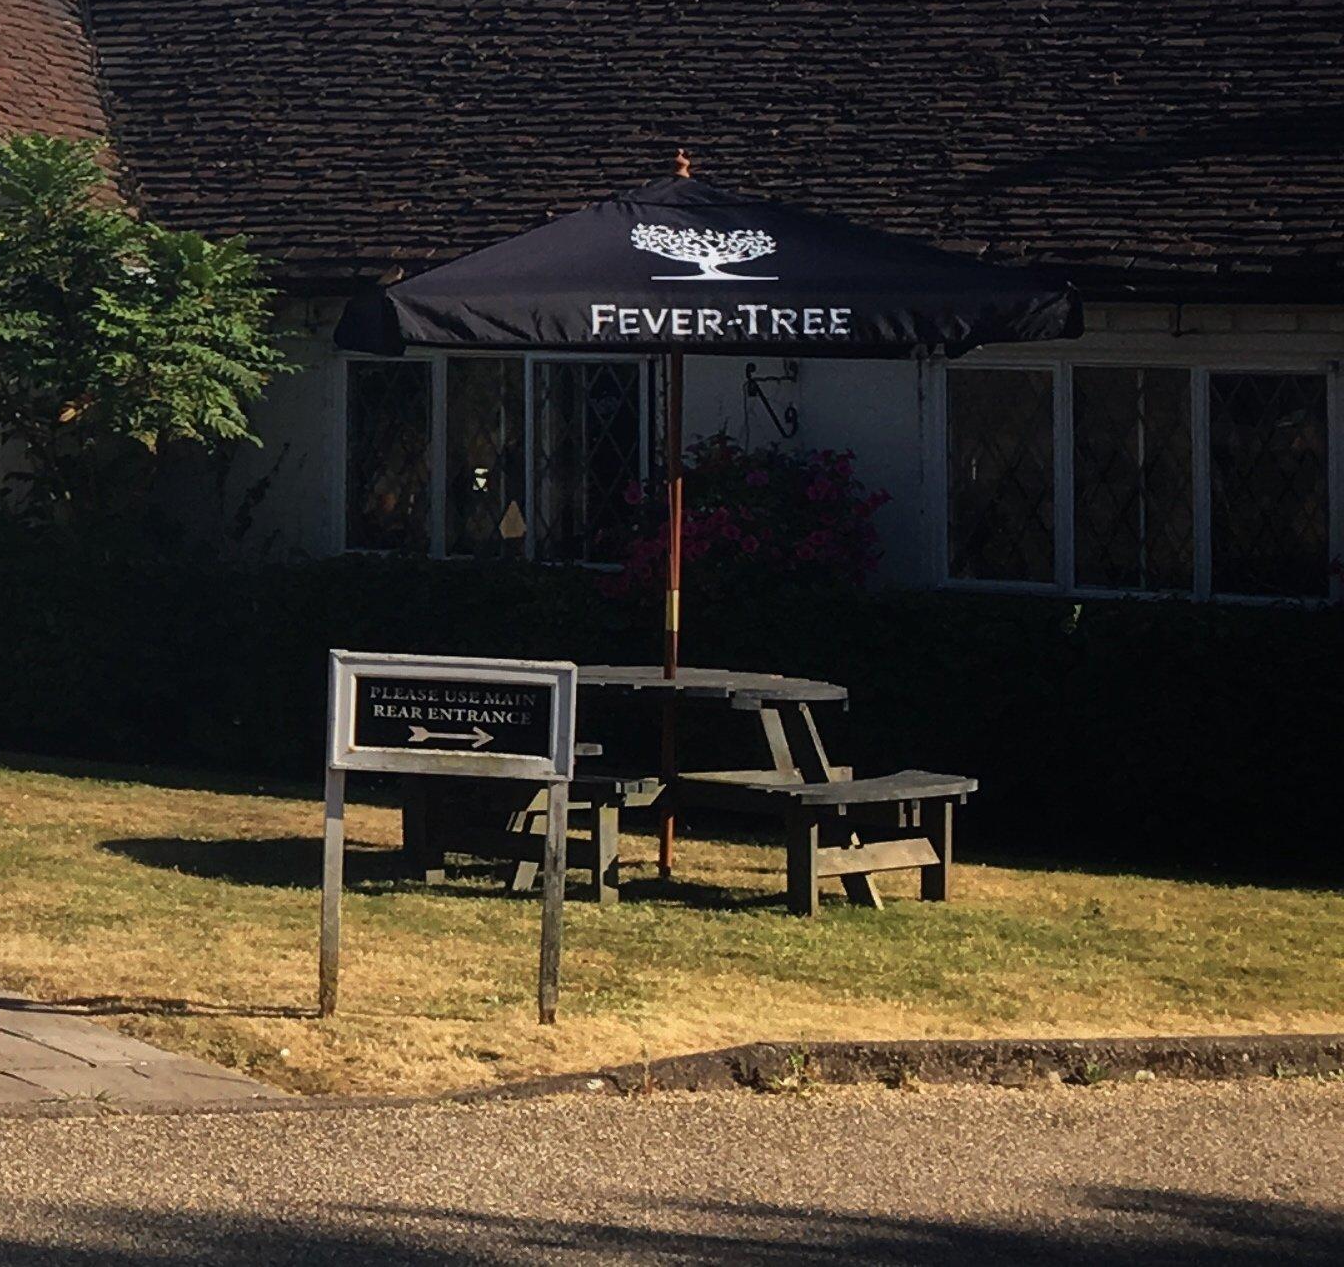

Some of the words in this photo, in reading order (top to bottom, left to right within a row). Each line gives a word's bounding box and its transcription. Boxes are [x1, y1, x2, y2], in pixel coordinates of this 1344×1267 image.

[590, 304, 852, 336] FEVER-TREE
[370, 685, 439, 702] PLEASE
[445, 689, 480, 705] USE
[484, 691, 537, 708] MAIN
[373, 704, 423, 720] REAR
[427, 707, 533, 726] ENTRANCE
